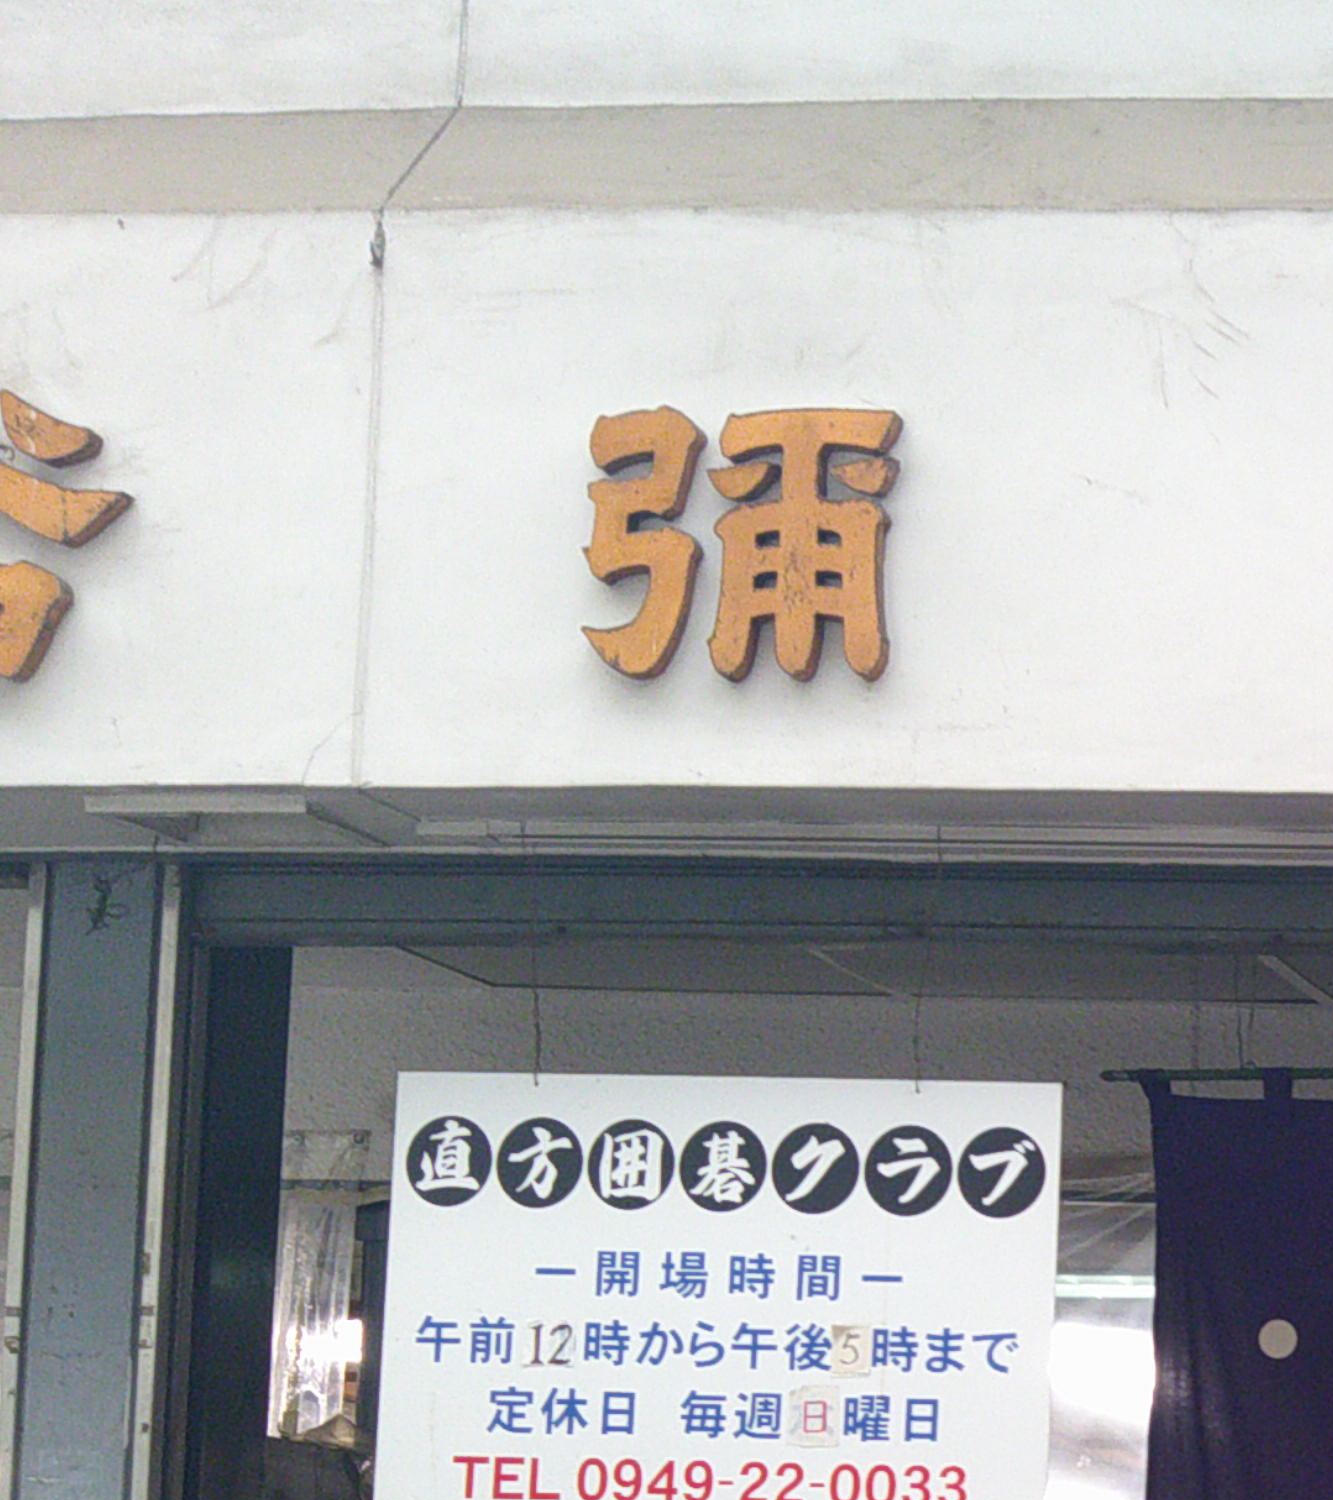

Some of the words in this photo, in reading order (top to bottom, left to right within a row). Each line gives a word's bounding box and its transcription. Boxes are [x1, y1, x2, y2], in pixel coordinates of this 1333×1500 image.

[581, 404, 904, 683] 彌
[413, 1118, 1036, 1208] 直方囲碁クラブ
[415, 1315, 1019, 1375] 午前12時から午後5時まで
[487, 1386, 638, 1437] 定休日
[680, 1389, 940, 1443] 毎週日曜日
[452, 1455, 561, 1500] TEL
